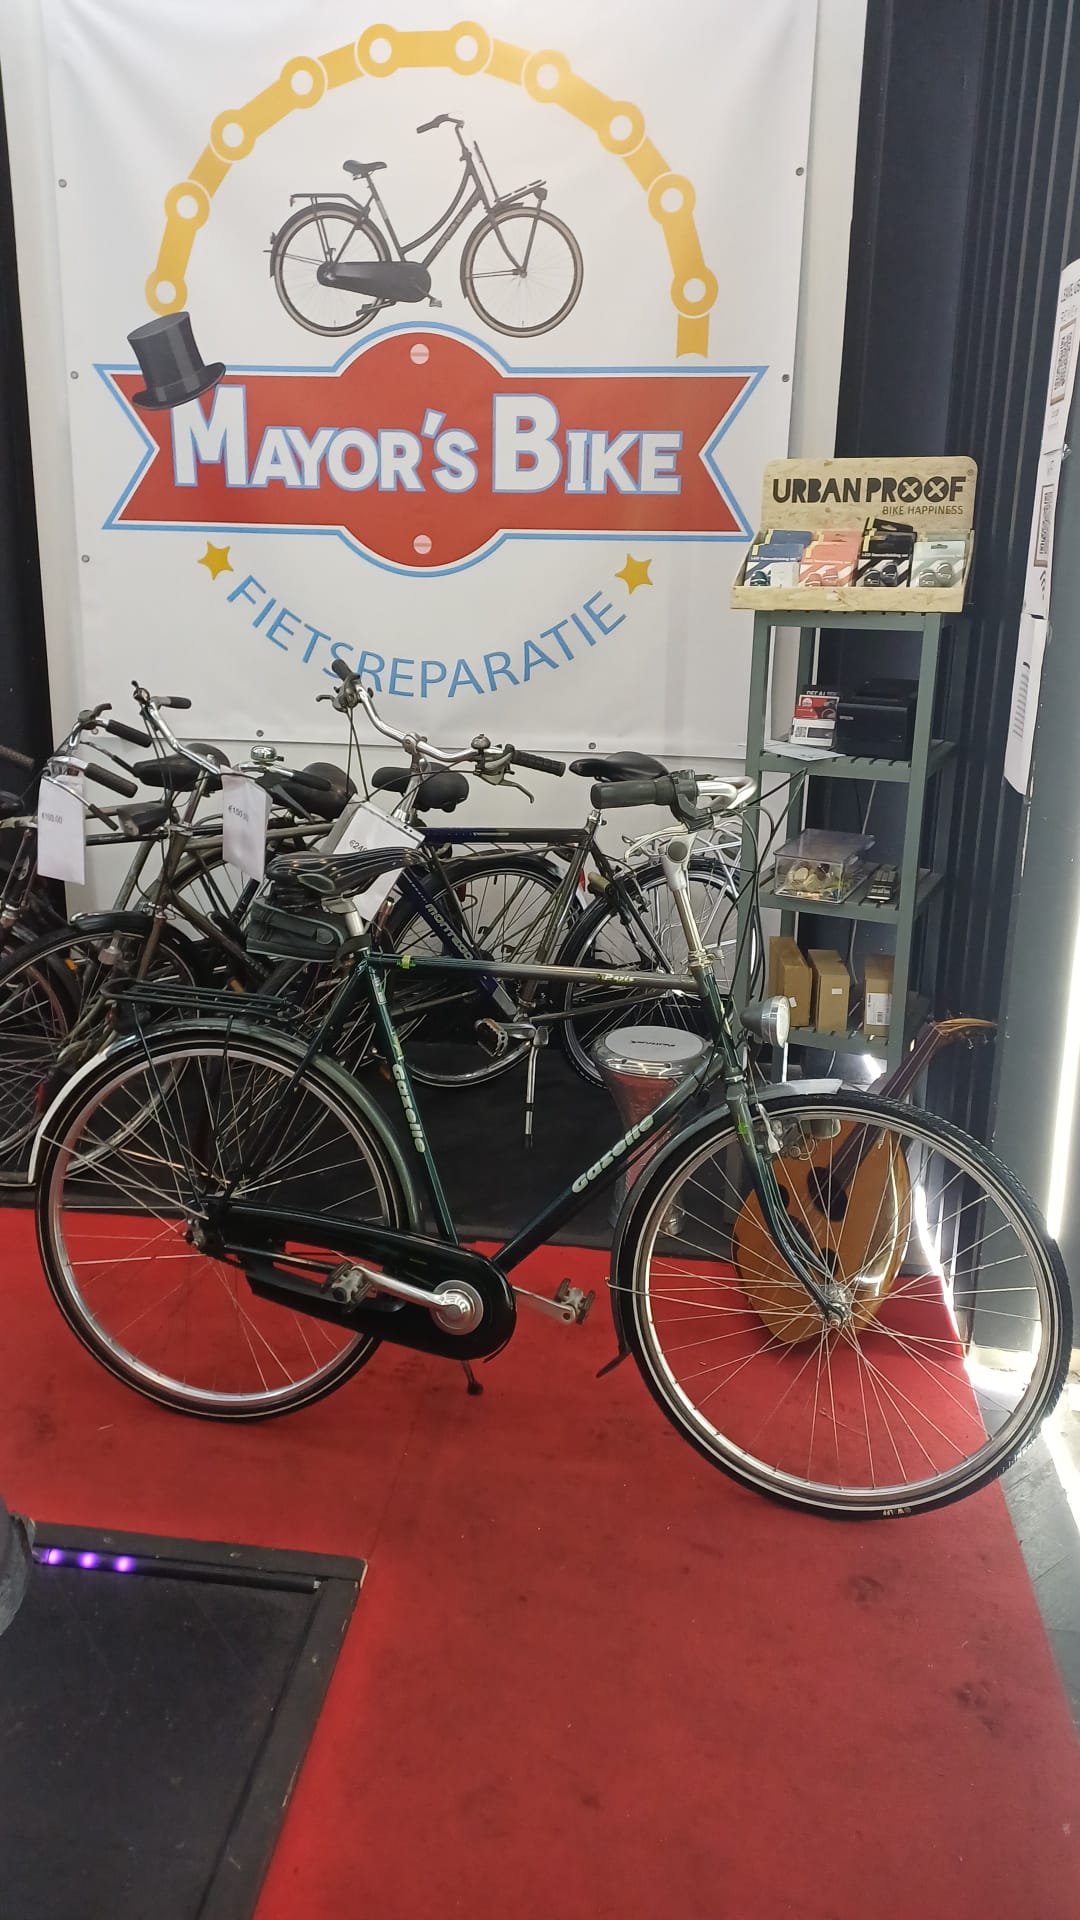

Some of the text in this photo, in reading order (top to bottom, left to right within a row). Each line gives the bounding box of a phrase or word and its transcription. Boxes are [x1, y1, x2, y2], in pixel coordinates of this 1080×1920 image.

[171, 384, 683, 494] MAYOR'S BIKE
[773, 476, 966, 503] URBAN PROOF
[882, 505, 963, 515] BIKE HAPPINESS
[227, 575, 627, 698] FIETSREPARATIE
[392, 1063, 426, 1152] Gazelle
[572, 1114, 654, 1193] Gazelle
